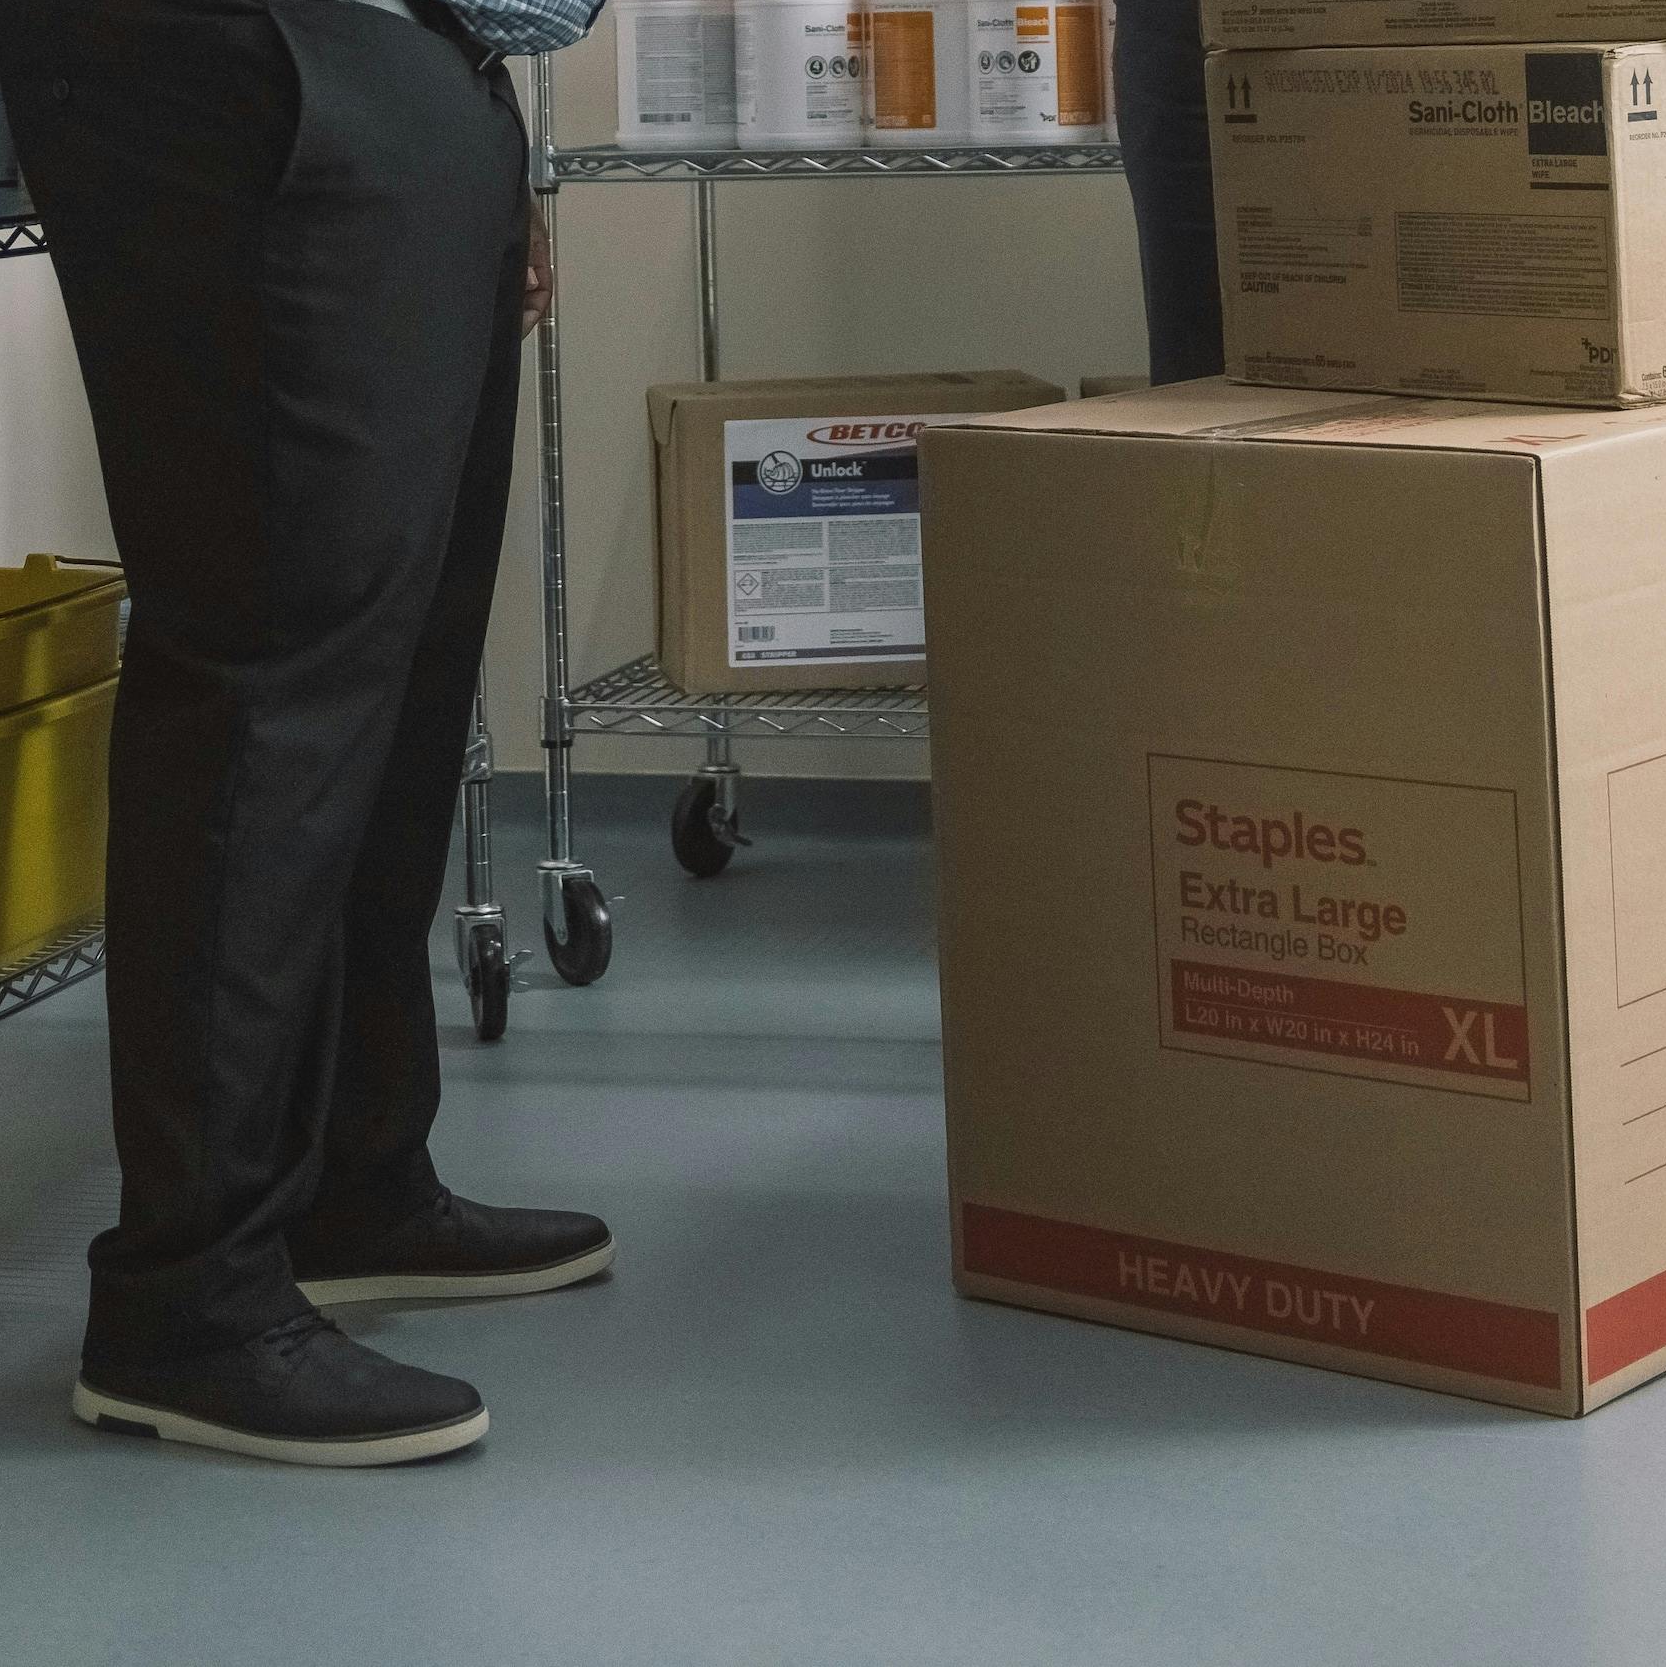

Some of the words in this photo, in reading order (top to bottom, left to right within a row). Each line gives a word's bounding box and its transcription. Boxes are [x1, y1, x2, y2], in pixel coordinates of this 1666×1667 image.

[1409, 100, 1519, 124] Sani-Cloth
[1528, 100, 1605, 124] Bleach
[1629, 132, 1651, 141] REORDER
[1532, 158, 1553, 168] EXTRA
[1554, 158, 1577, 168] LARGE
[1241, 282, 1279, 293] CAUTION
[812, 462, 864, 478] Unlock
[1175, 799, 1367, 868] Staples
[1180, 871, 1280, 920] Extra
[1293, 885, 1407, 942] Large
[1181, 915, 1309, 961] Rectangle
[1317, 933, 1369, 966] Box
[1184, 971, 1294, 1006] Multi-Depth
[1186, 1004, 1219, 1027] L20
[1225, 1010, 1242, 1030] in
[1250, 1018, 1260, 1031] x
[1265, 1017, 1308, 1039] W20
[1313, 1023, 1332, 1044] in
[1338, 1031, 1349, 1045] x
[1356, 1029, 1393, 1055] H24
[1401, 1034, 1419, 1056] in
[1443, 1006, 1518, 1069] XL
[1117, 1251, 1251, 1307] HEAVY
[1263, 1278, 1377, 1337] DUTY
